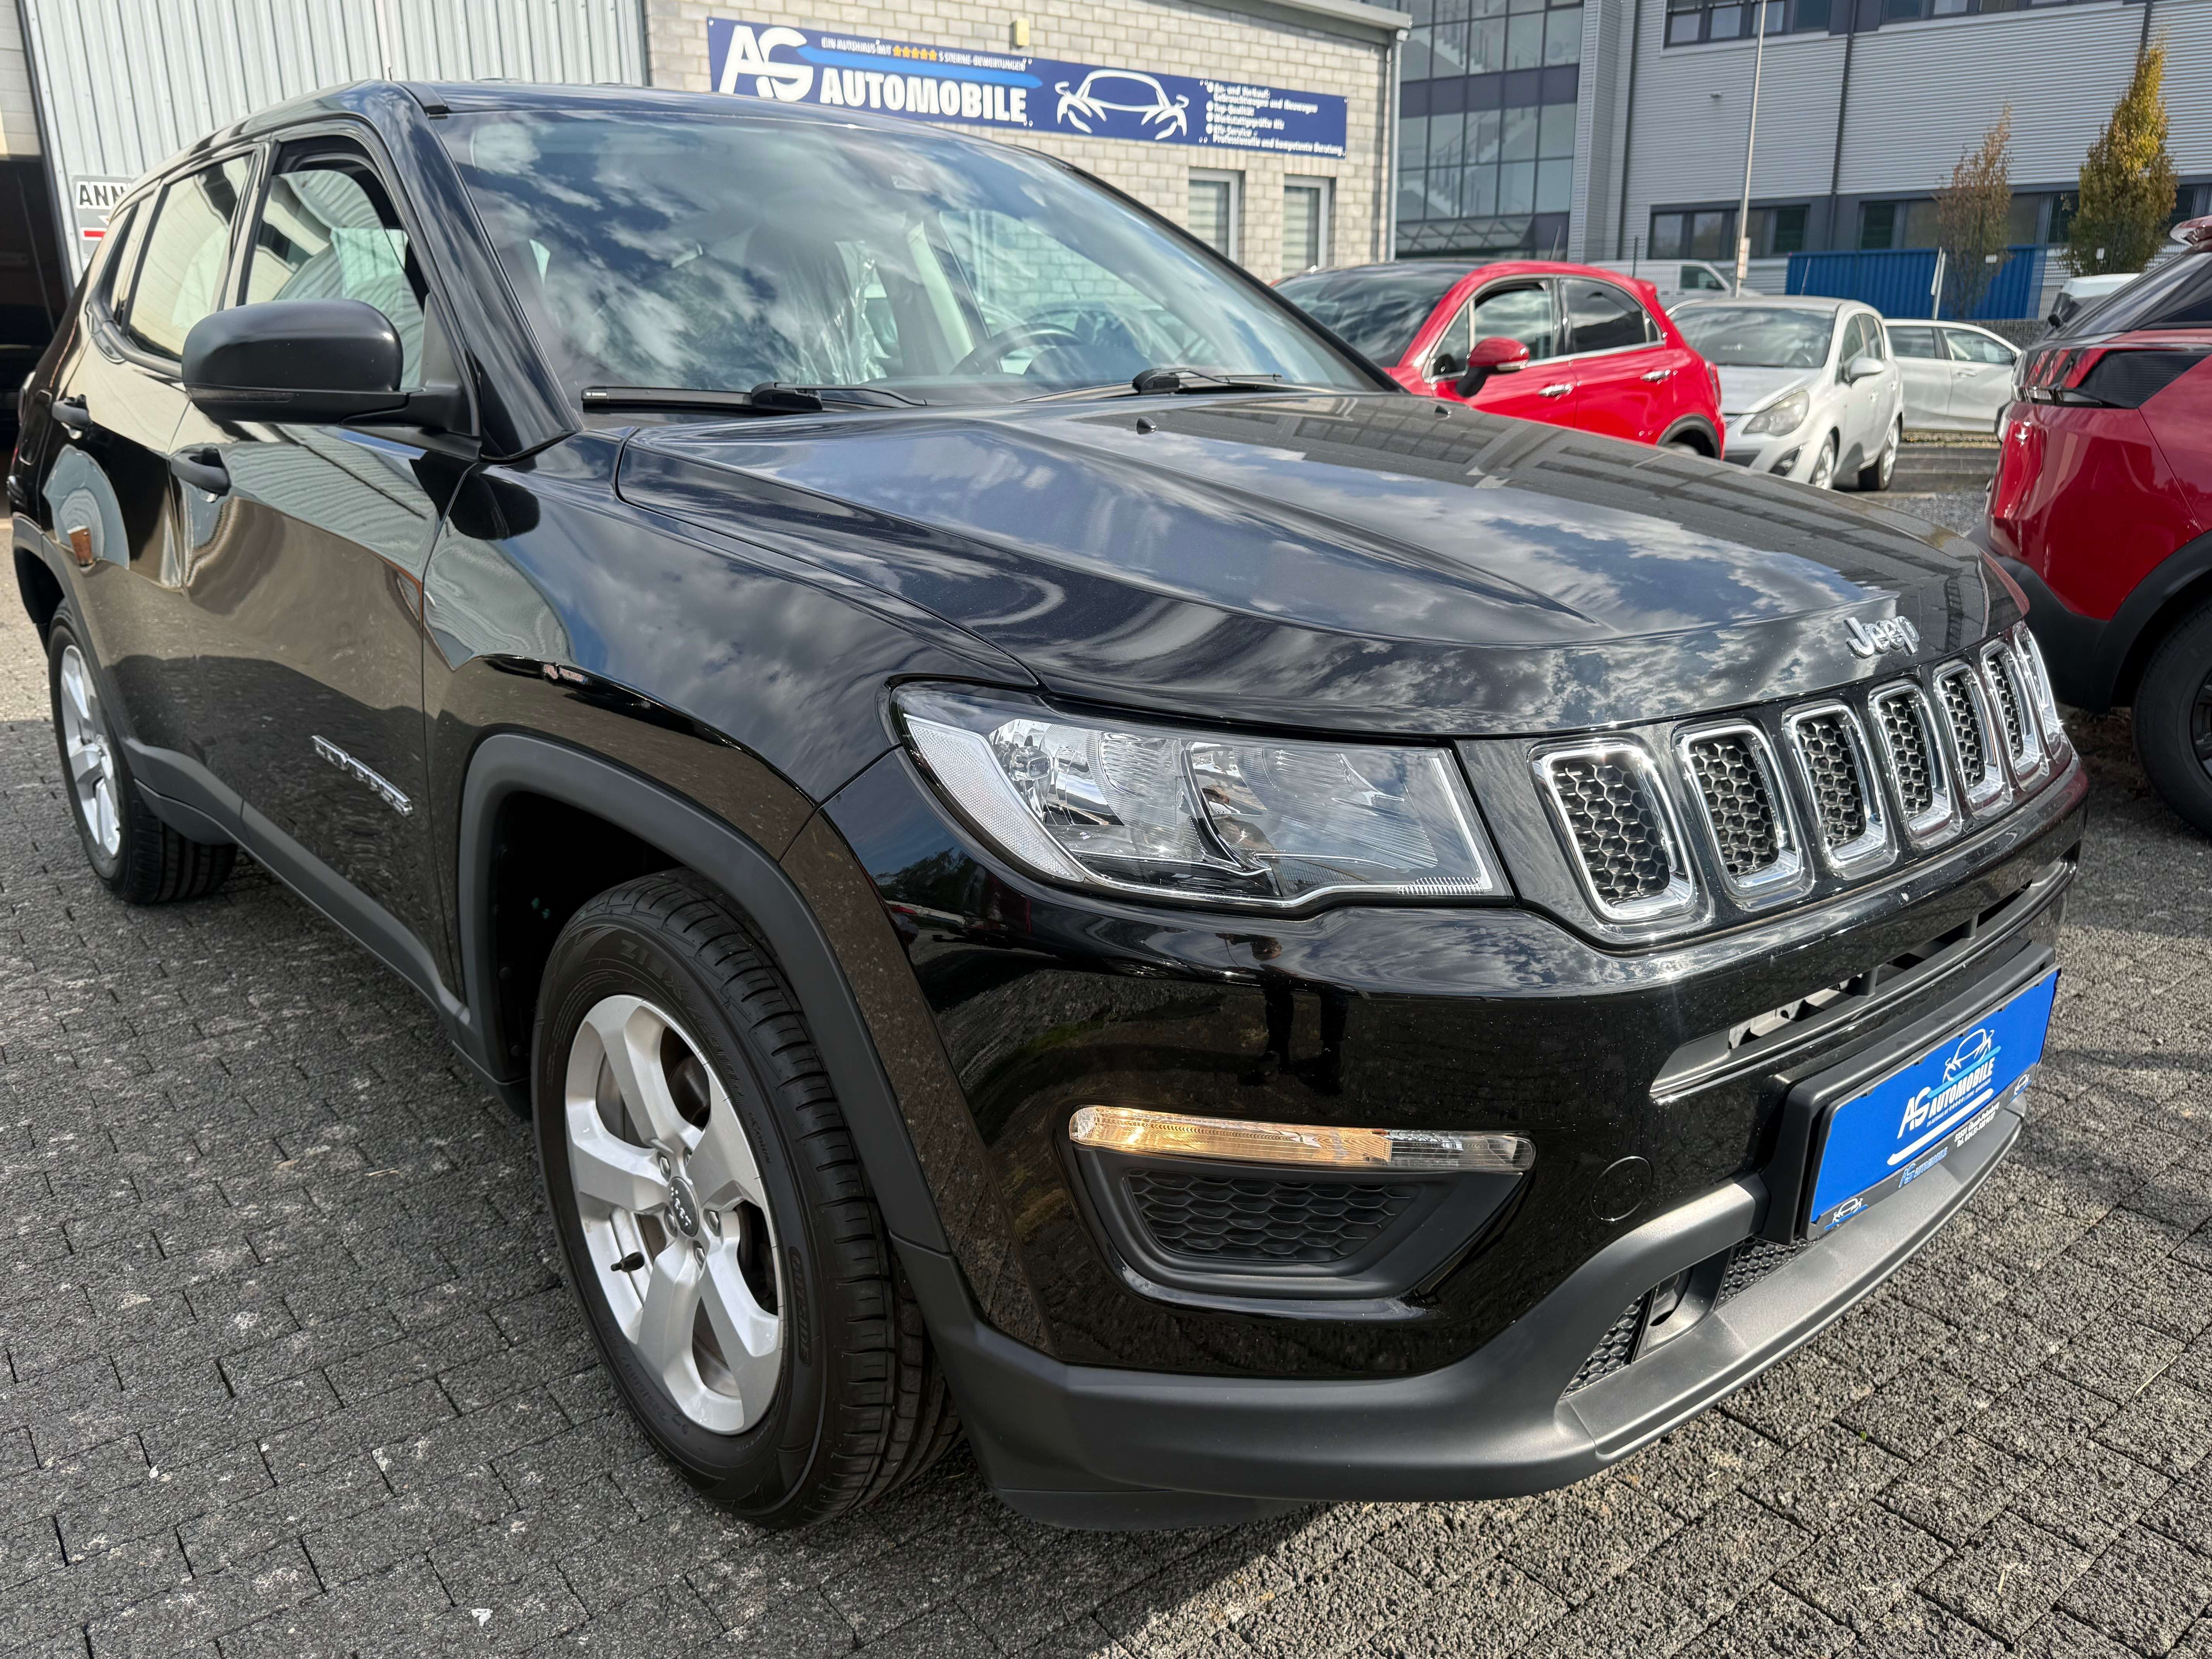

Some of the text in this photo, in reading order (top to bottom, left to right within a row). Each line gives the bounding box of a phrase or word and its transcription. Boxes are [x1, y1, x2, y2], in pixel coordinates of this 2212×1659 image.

[820, 67, 1027, 122] AUTOMOBILE
[1844, 616, 1920, 659] Jeep
[1929, 1057, 1995, 1118] AUTOMOBILE
[792, 1255, 809, 1359] OUTSIDE
